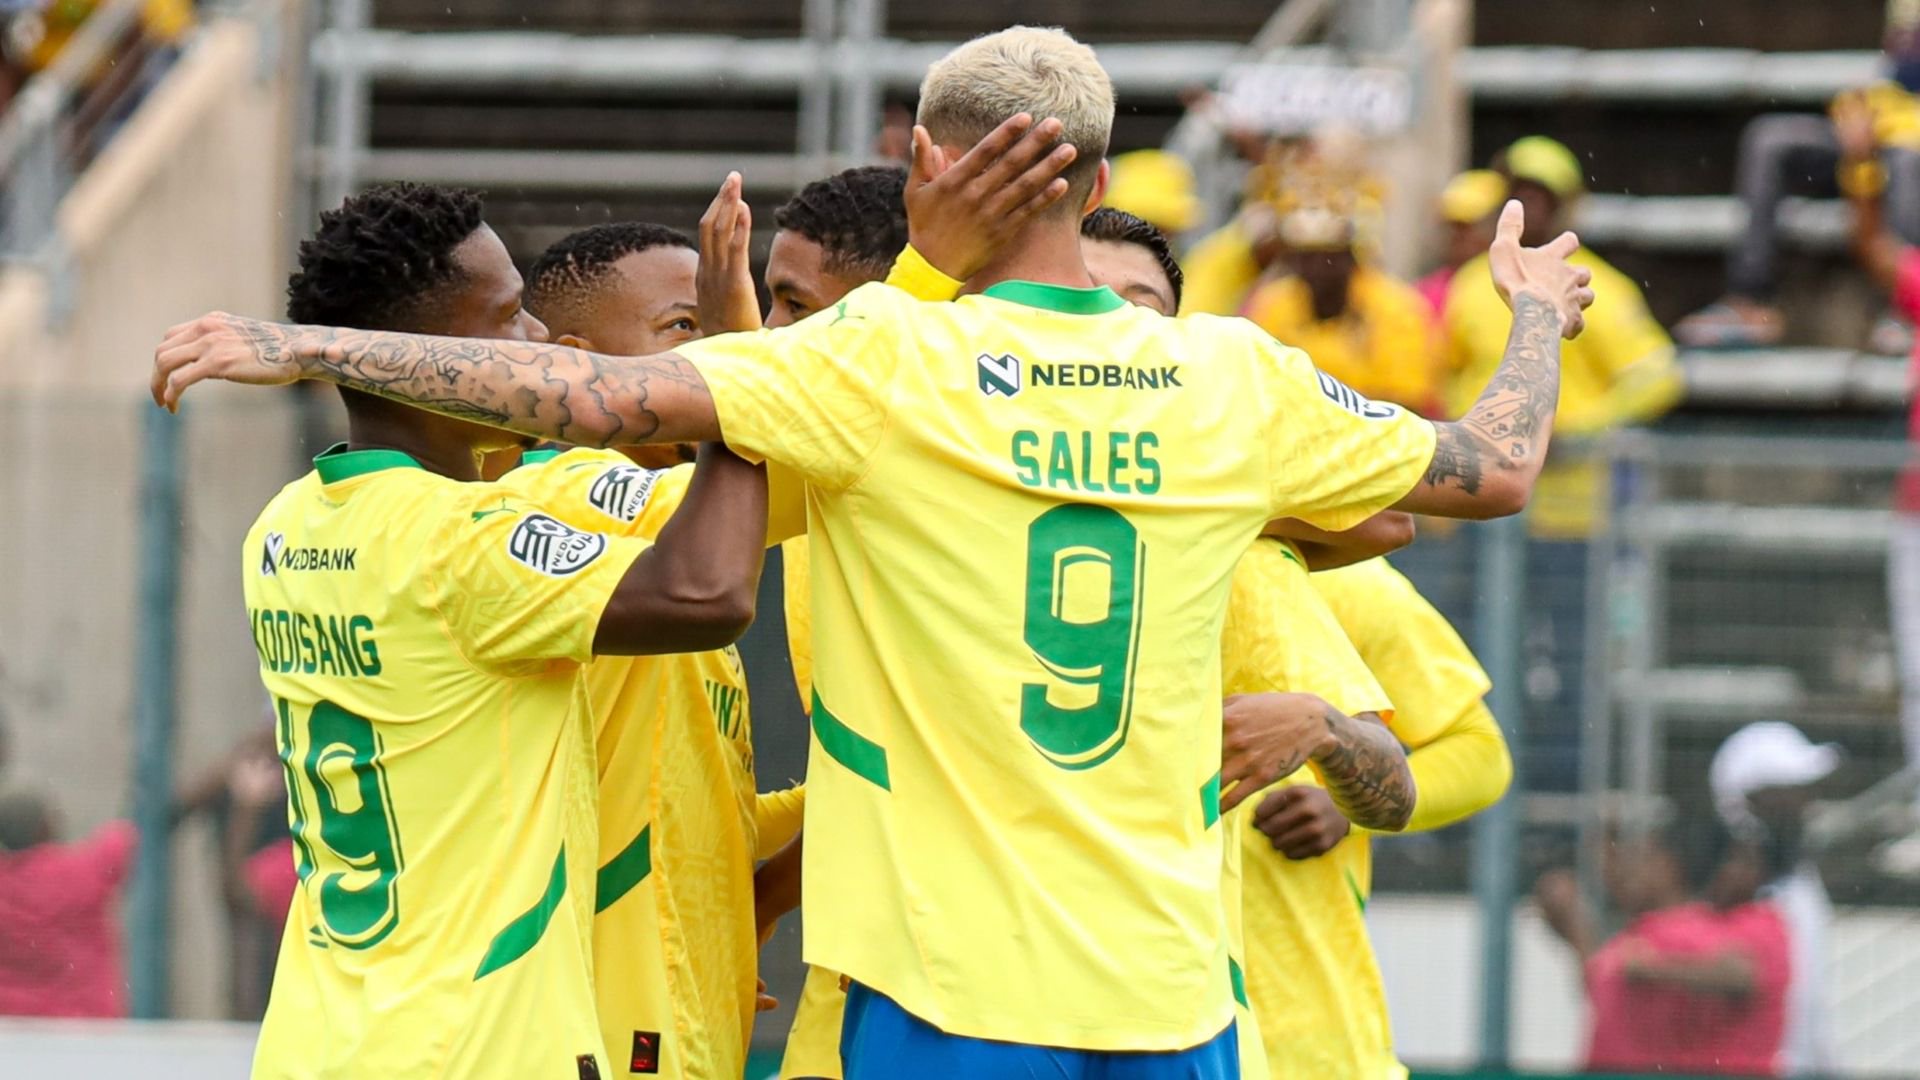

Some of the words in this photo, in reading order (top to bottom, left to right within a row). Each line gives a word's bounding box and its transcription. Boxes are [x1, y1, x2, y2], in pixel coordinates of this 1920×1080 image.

[1031, 364, 1183, 390] NEDBANK
[1011, 430, 1161, 495] SALES
[279, 547, 358, 571] NEDBANK
[1019, 502, 1146, 771] 9
[277, 697, 405, 950] 19
